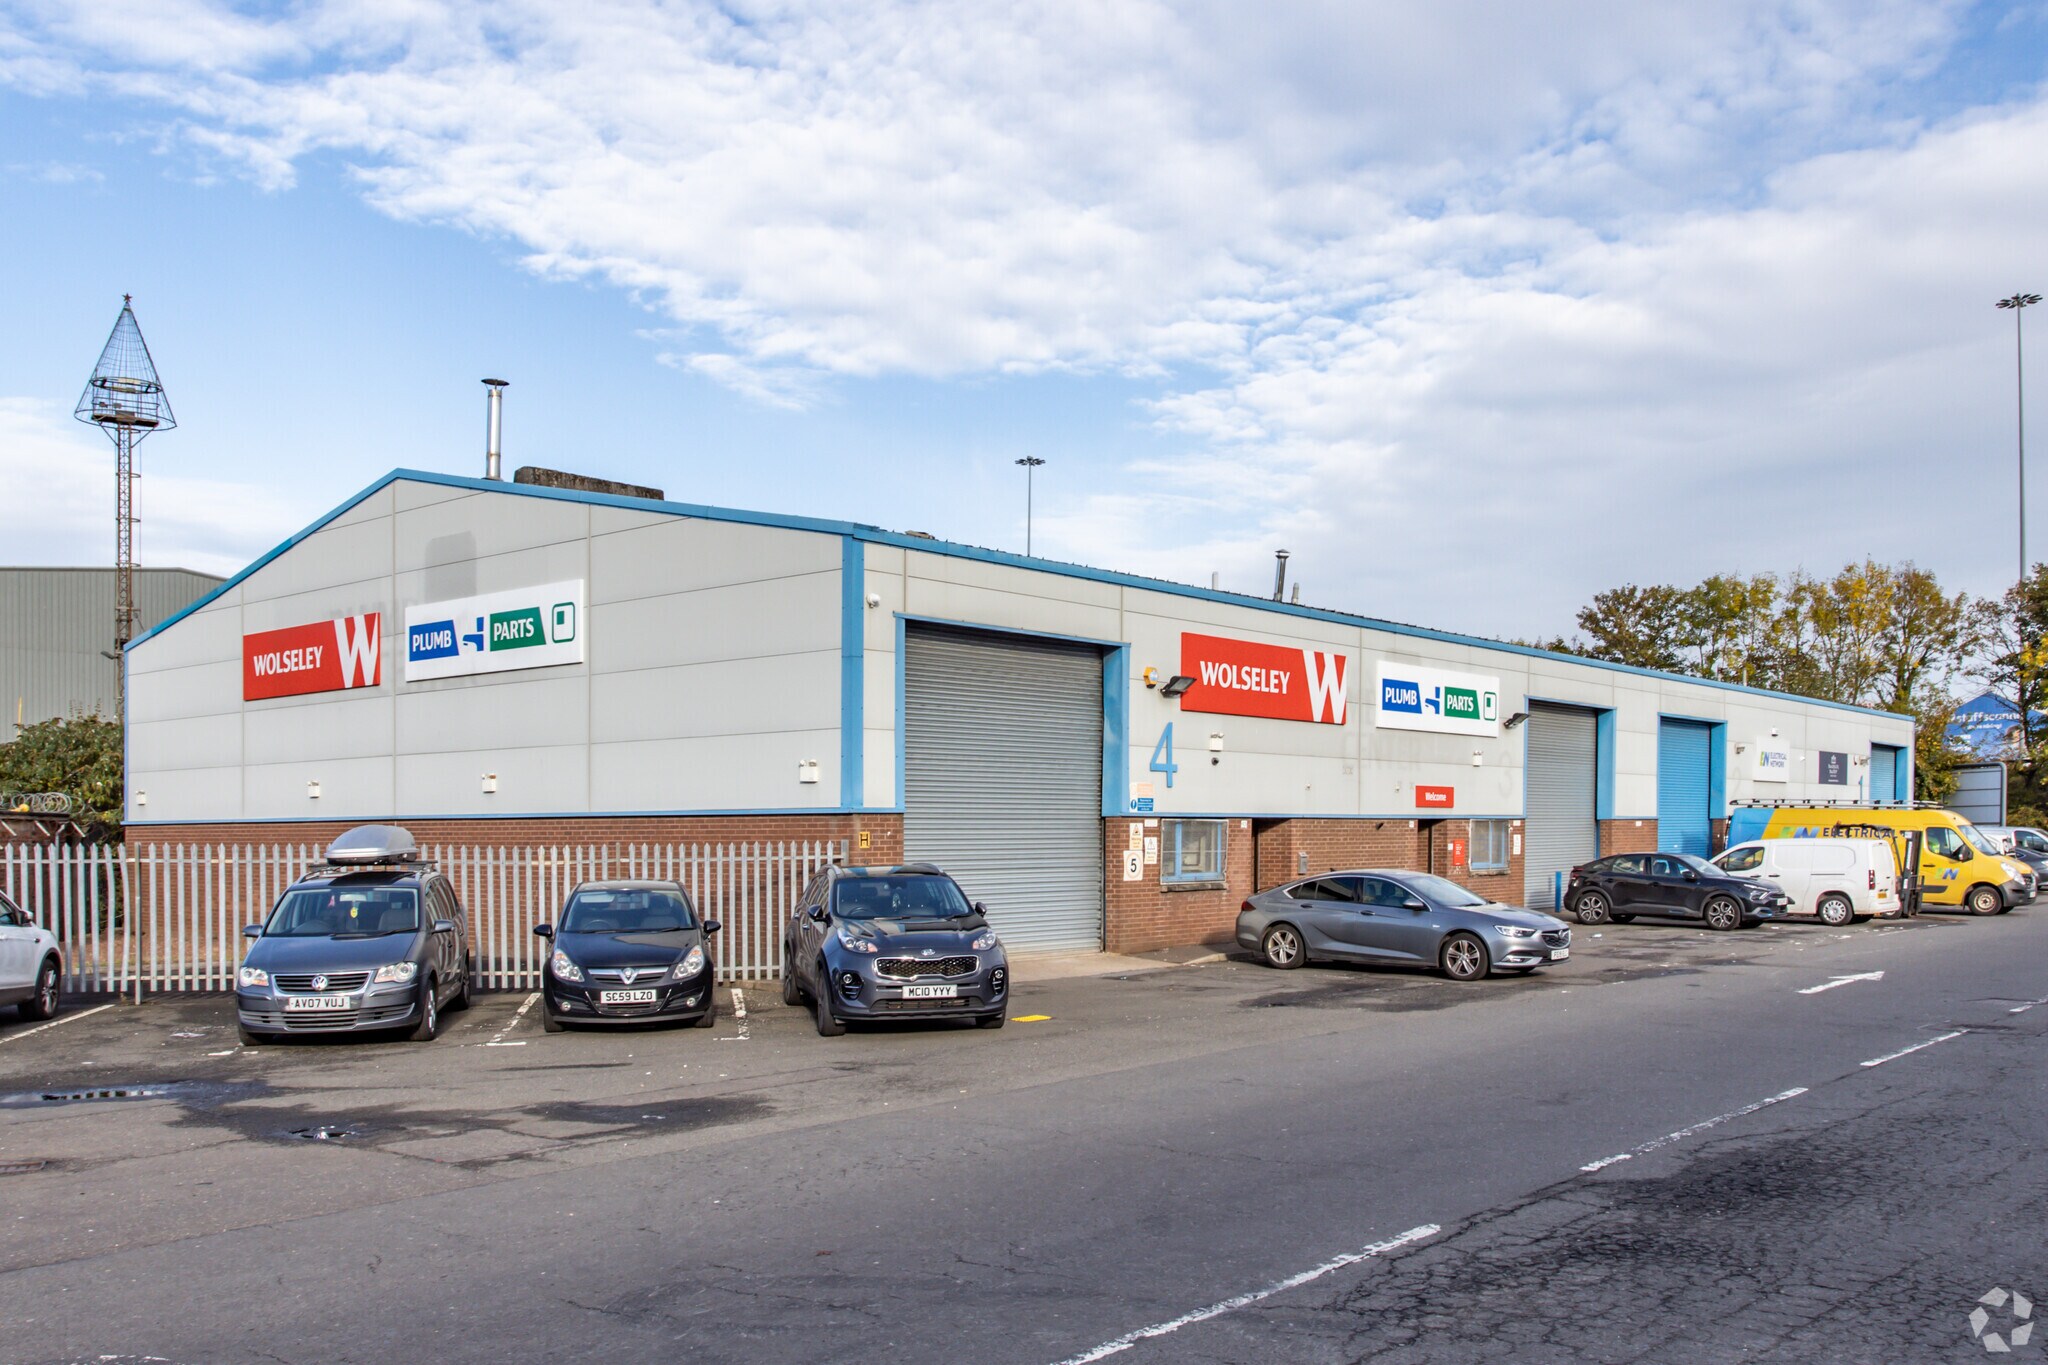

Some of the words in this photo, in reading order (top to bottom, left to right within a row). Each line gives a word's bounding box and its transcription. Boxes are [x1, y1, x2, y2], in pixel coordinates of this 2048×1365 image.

[494, 617, 534, 642] PARTS
[334, 612, 378, 689] W
[412, 630, 452, 652] PLUMB
[253, 645, 323, 676] WOLSELEY
[1200, 660, 1290, 694] WOLSELEY
[1302, 649, 1347, 724] W
[1385, 686, 1417, 706] PLUMB
[1446, 693, 1474, 712] PARTS
[1150, 722, 1178, 788] 4
[1425, 792, 1447, 801] Welcome
[860, 833, 869, 847] H
[1130, 858, 1137, 873] 5
[908, 987, 930, 997] MC10
[933, 986, 951, 995] YYY
[294, 998, 321, 1008] AV07
[324, 998, 344, 1007] VUJ
